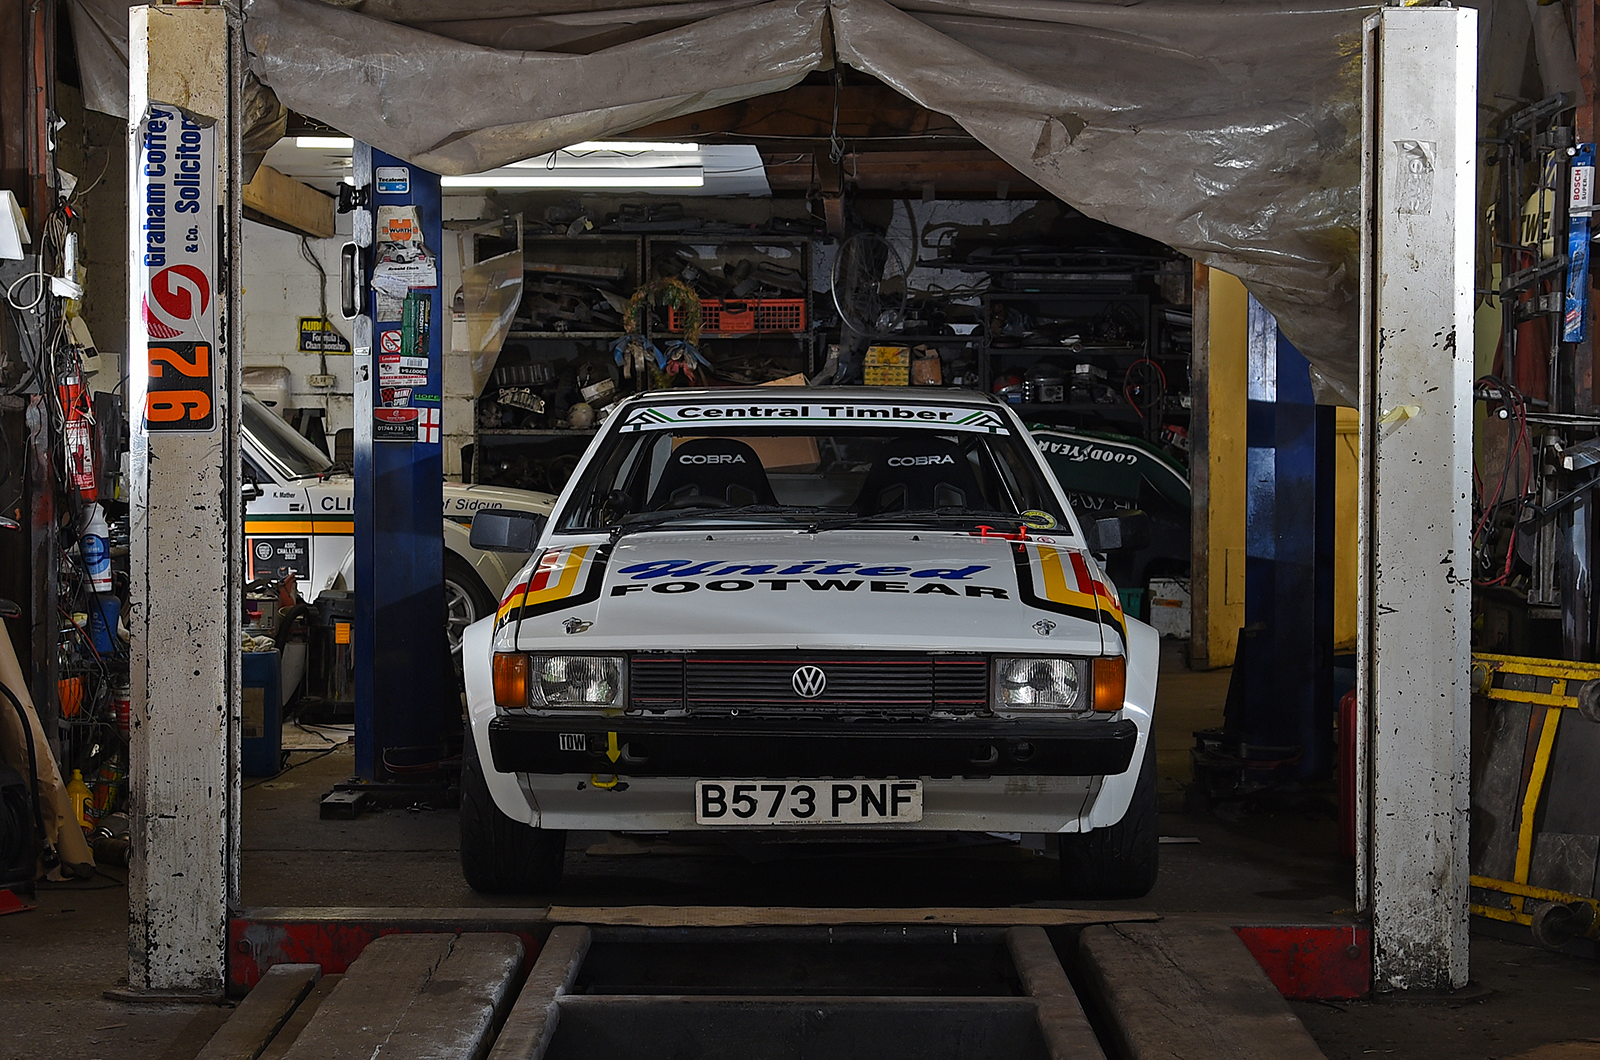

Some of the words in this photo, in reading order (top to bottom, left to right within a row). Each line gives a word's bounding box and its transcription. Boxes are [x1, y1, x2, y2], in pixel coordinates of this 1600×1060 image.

[144, 108, 174, 177] Coffey
[143, 183, 166, 267] Graham
[186, 225, 198, 241] Co.
[185, 244, 198, 253] &
[312, 333, 336, 342] Fomula
[144, 346, 211, 422] 92
[677, 406, 809, 418] Central
[821, 406, 953, 421] Timber
[679, 454, 746, 464] COBRA
[887, 454, 955, 467] COBRA
[1037, 439, 1138, 466] GOODYEAR
[321, 496, 354, 511] CLI
[617, 559, 992, 580] United
[610, 579, 1010, 600] FOOTWEAR
[560, 734, 585, 750] TOW
[701, 784, 816, 818] B573
[831, 783, 917, 818] PNF
